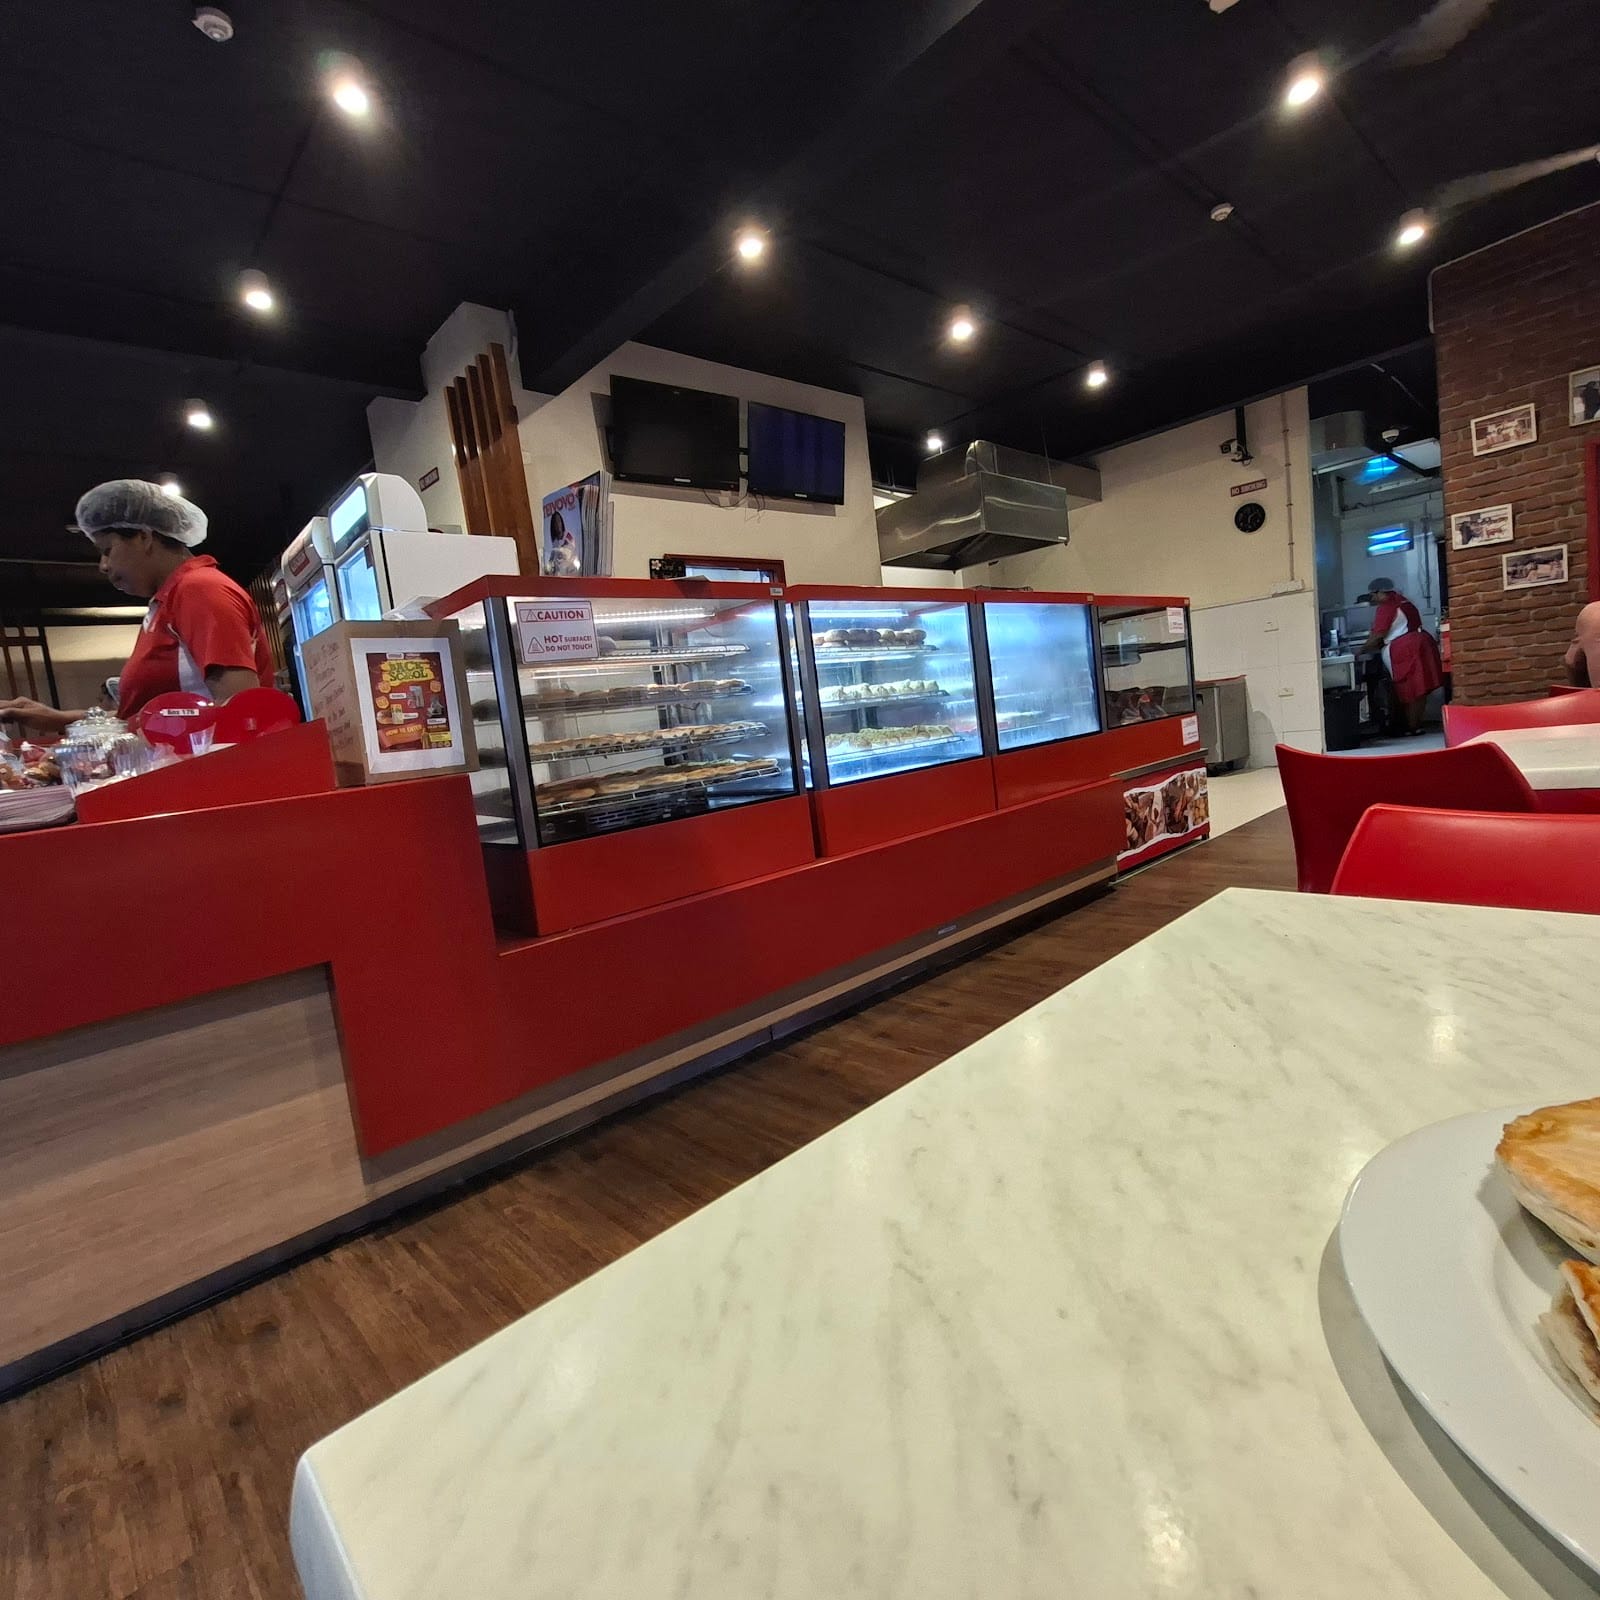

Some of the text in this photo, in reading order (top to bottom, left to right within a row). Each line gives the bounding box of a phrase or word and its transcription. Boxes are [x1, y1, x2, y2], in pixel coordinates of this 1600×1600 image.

[537, 610, 584, 620] CAUTION
[544, 635, 563, 643] HOT
[572, 643, 593, 651] TOUCH
